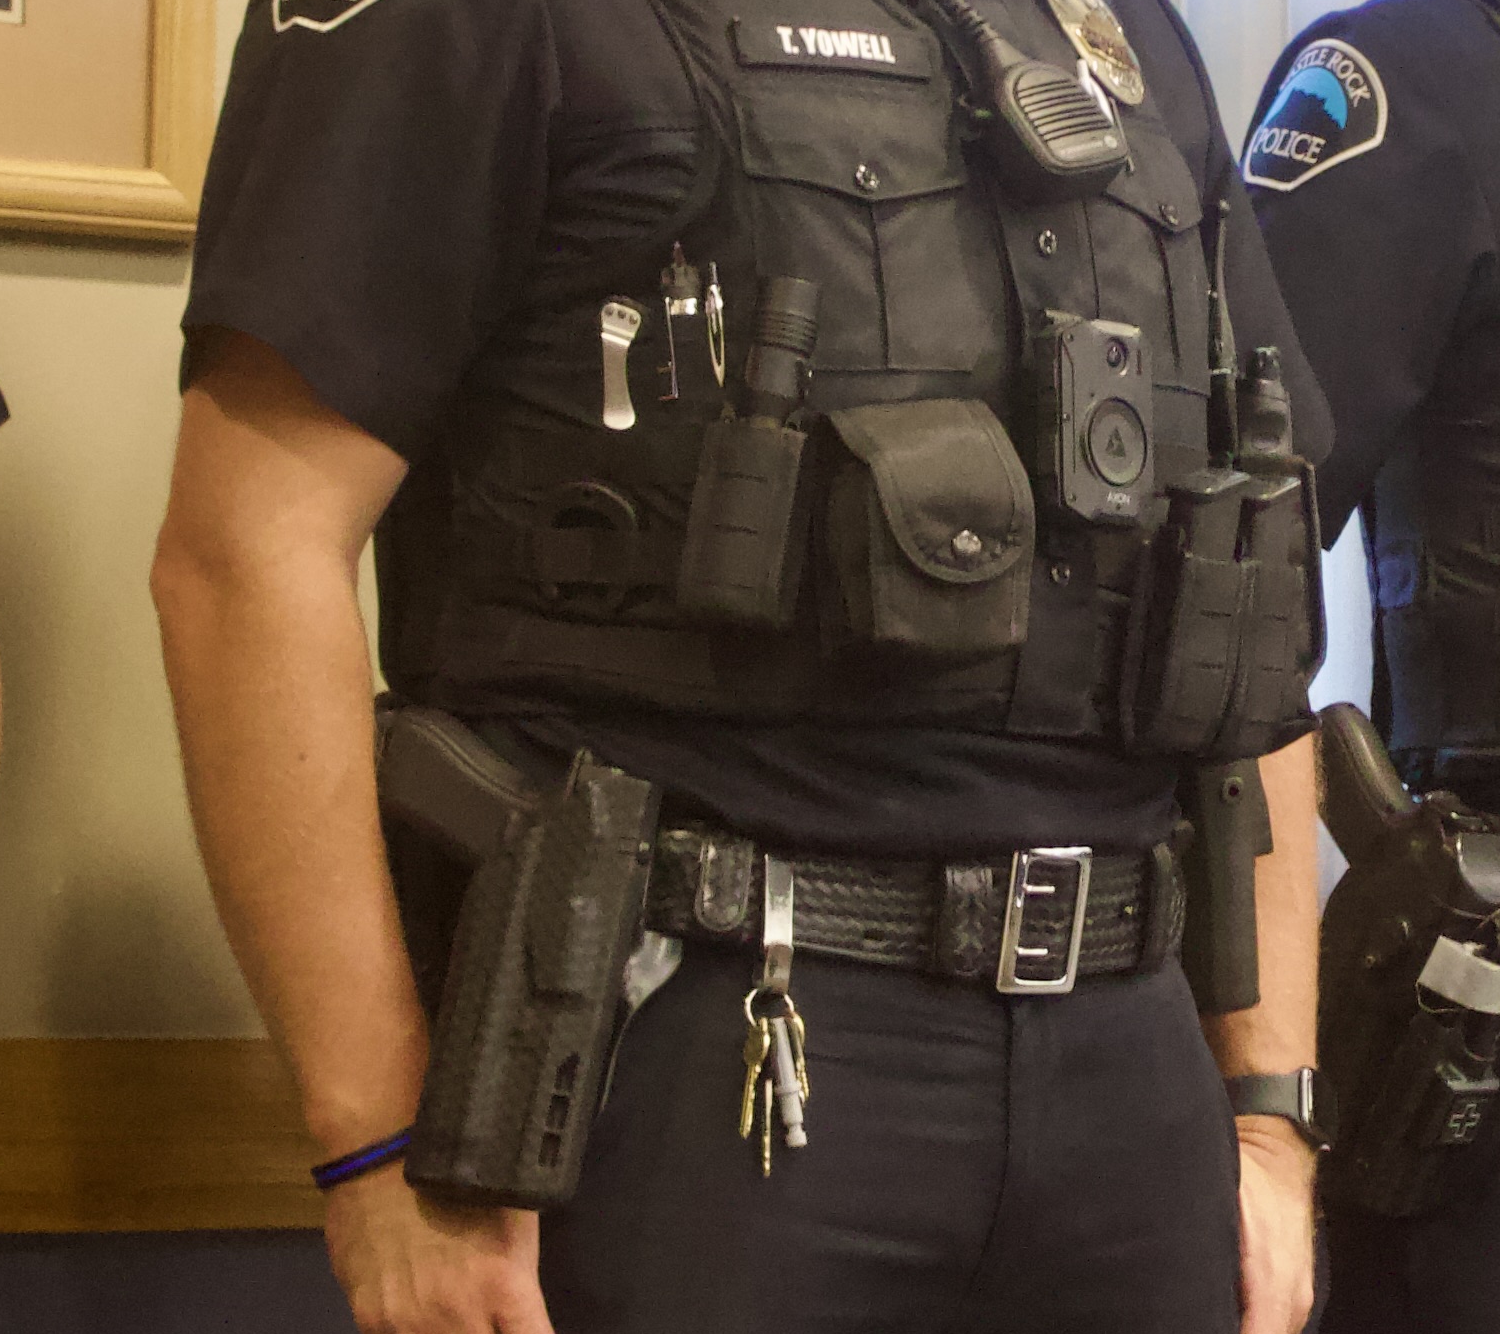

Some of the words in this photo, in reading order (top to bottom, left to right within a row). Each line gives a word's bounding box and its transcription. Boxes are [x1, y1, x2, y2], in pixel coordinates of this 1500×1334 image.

[775, 25, 800, 55] T.
[798, 26, 897, 65] YOWELL
[1326, 51, 1372, 108] ROCK
[1252, 127, 1327, 165] POLICE
